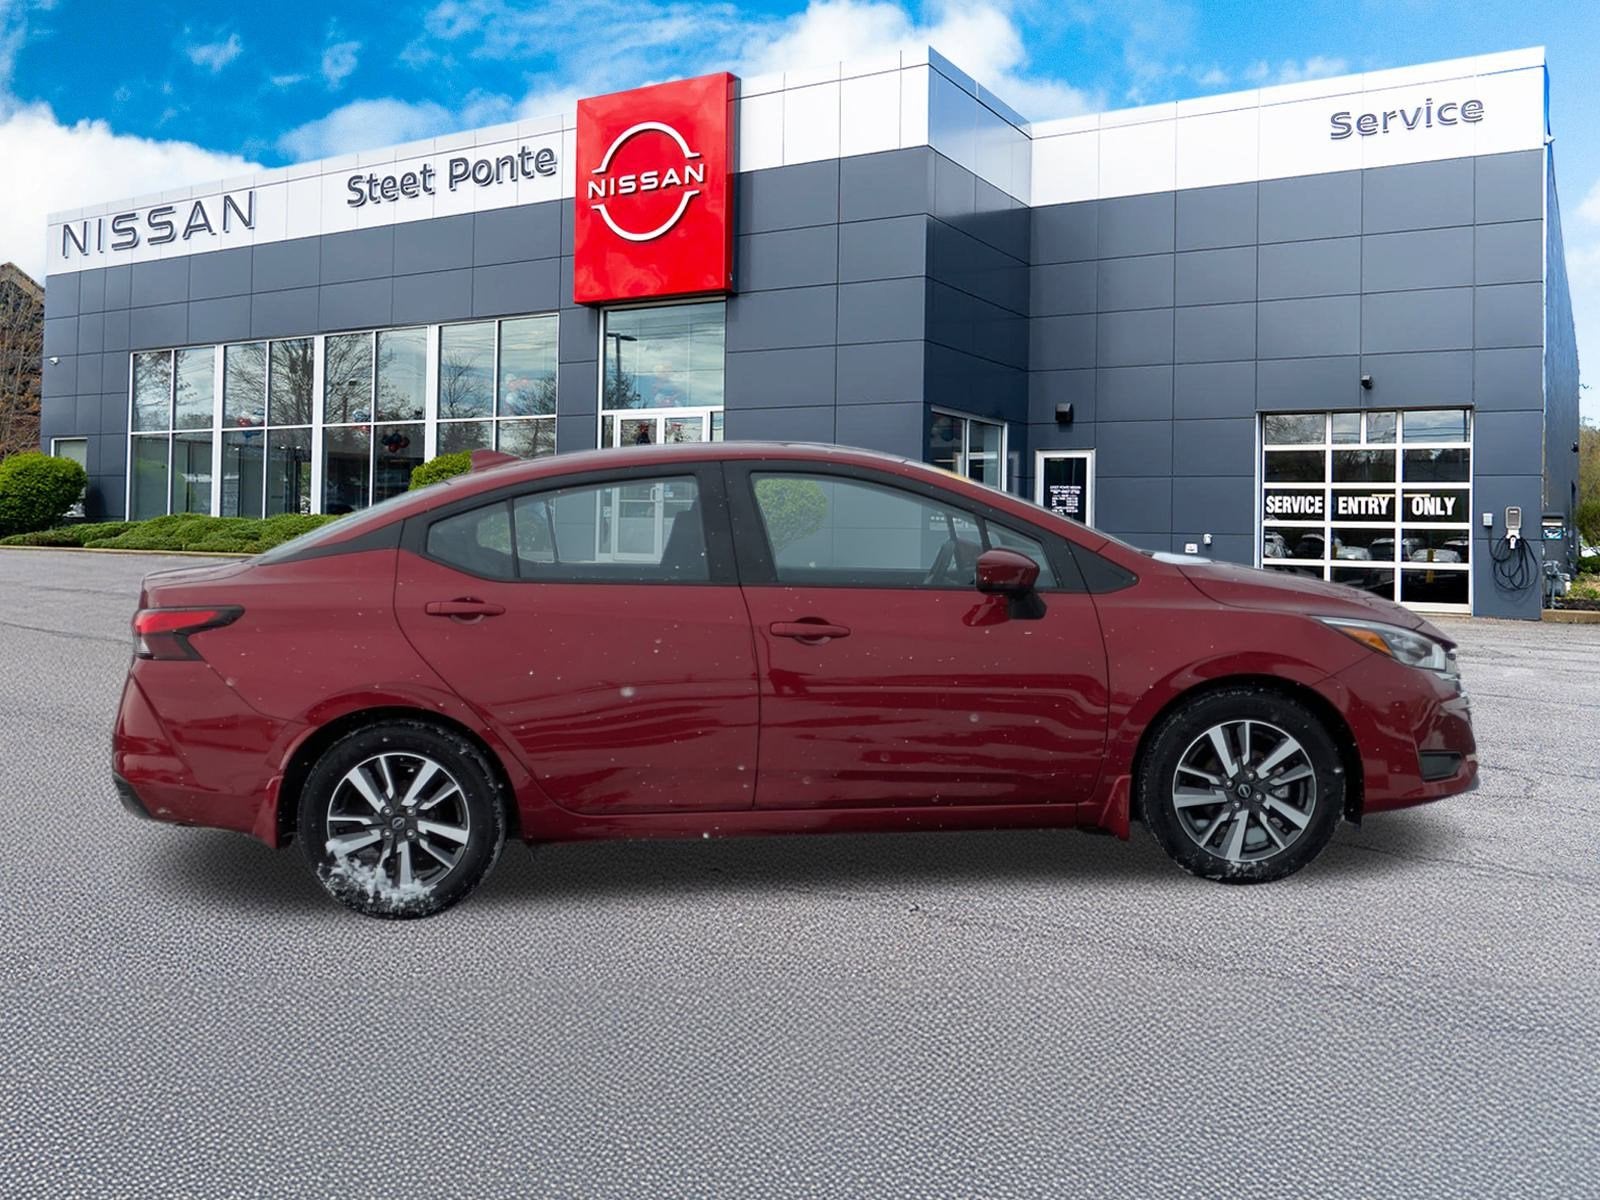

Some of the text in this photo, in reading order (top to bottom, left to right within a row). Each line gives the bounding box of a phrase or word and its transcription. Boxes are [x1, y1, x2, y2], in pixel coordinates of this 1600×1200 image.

[1330, 98, 1485, 140] Service
[347, 145, 557, 207] Steet Ponte
[588, 163, 704, 200] NISSAN
[63, 191, 256, 259] NISSAN
[1265, 495, 1456, 515] SERVICE ENTRY ONLY
